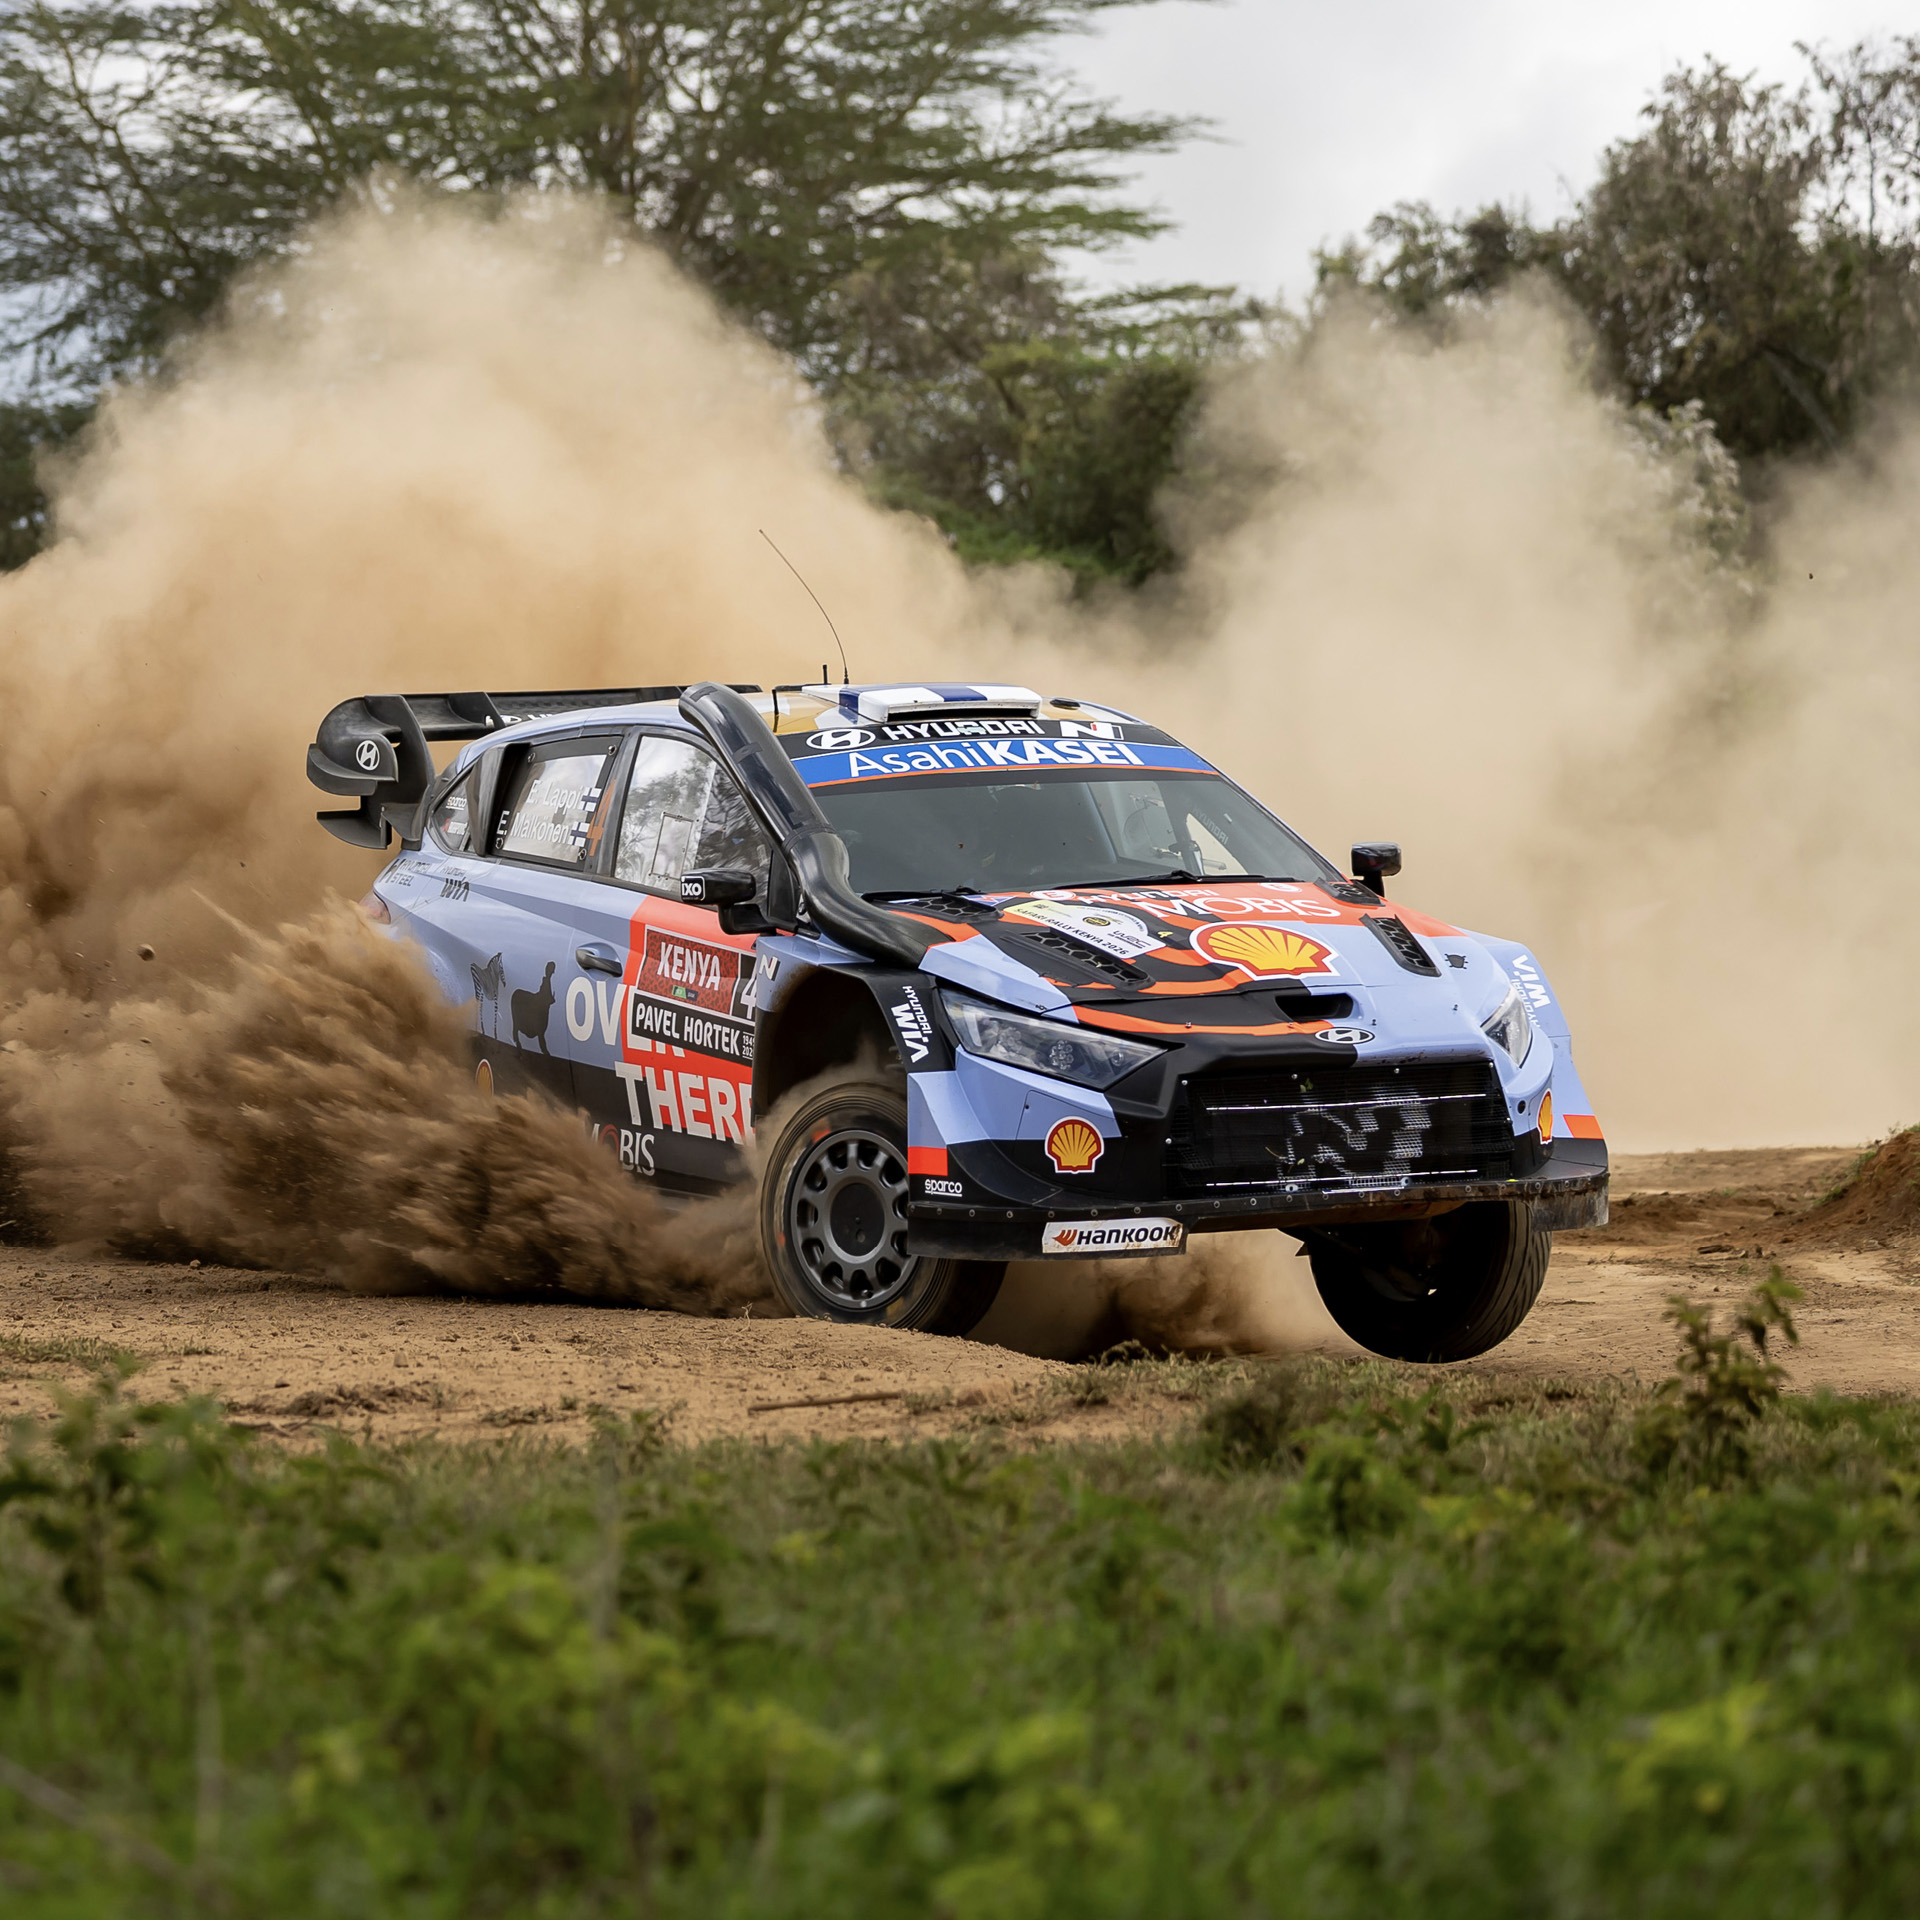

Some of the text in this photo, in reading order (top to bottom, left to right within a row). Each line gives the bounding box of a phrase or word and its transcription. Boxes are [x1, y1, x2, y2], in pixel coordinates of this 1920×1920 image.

[883, 721, 1045, 741] HYUNDAI
[849, 741, 1145, 778] AsahiKASEI
[542, 785, 584, 815] Lappi
[497, 811, 510, 835] E.
[1077, 889, 1219, 905] HYUNDAI
[1131, 897, 1341, 918] MOBIS
[1045, 918, 1075, 931] RALLY
[1072, 929, 1103, 944] KENYA
[1102, 941, 1129, 955] 2026
[657, 942, 720, 991] KENYA
[902, 985, 933, 1034] HYUNDAI
[636, 1002, 740, 1056] PAVEL HORTEK
[925, 1179, 963, 1195] sparco
